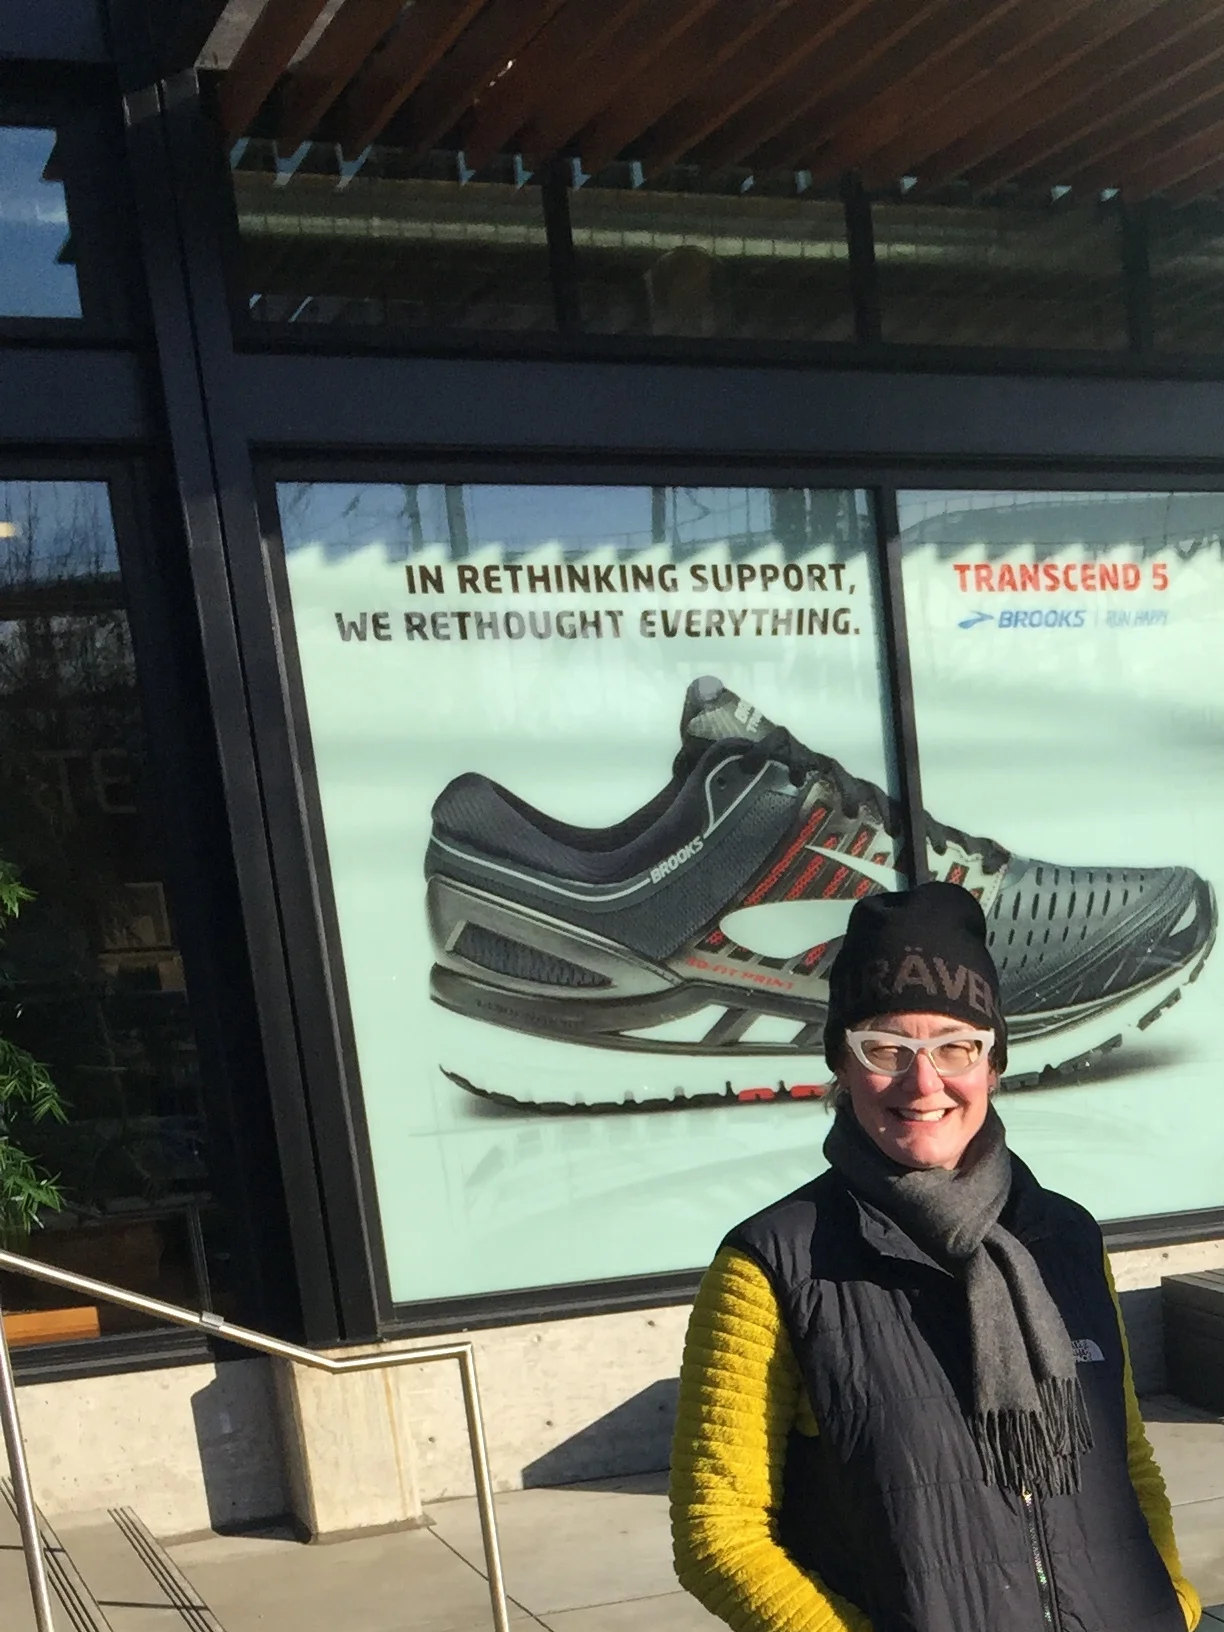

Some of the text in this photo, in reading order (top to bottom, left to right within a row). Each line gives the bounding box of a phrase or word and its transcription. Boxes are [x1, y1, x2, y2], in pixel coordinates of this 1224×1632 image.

[405, 562, 857, 596] IN RETHINKING SUPPORT,
[953, 562, 1170, 592] TRANSCEND 5
[335, 607, 861, 642] WE RETHOUGHT EVERYTHING.
[998, 609, 1087, 629] BROOKS
[650, 835, 704, 884] BROOKS
